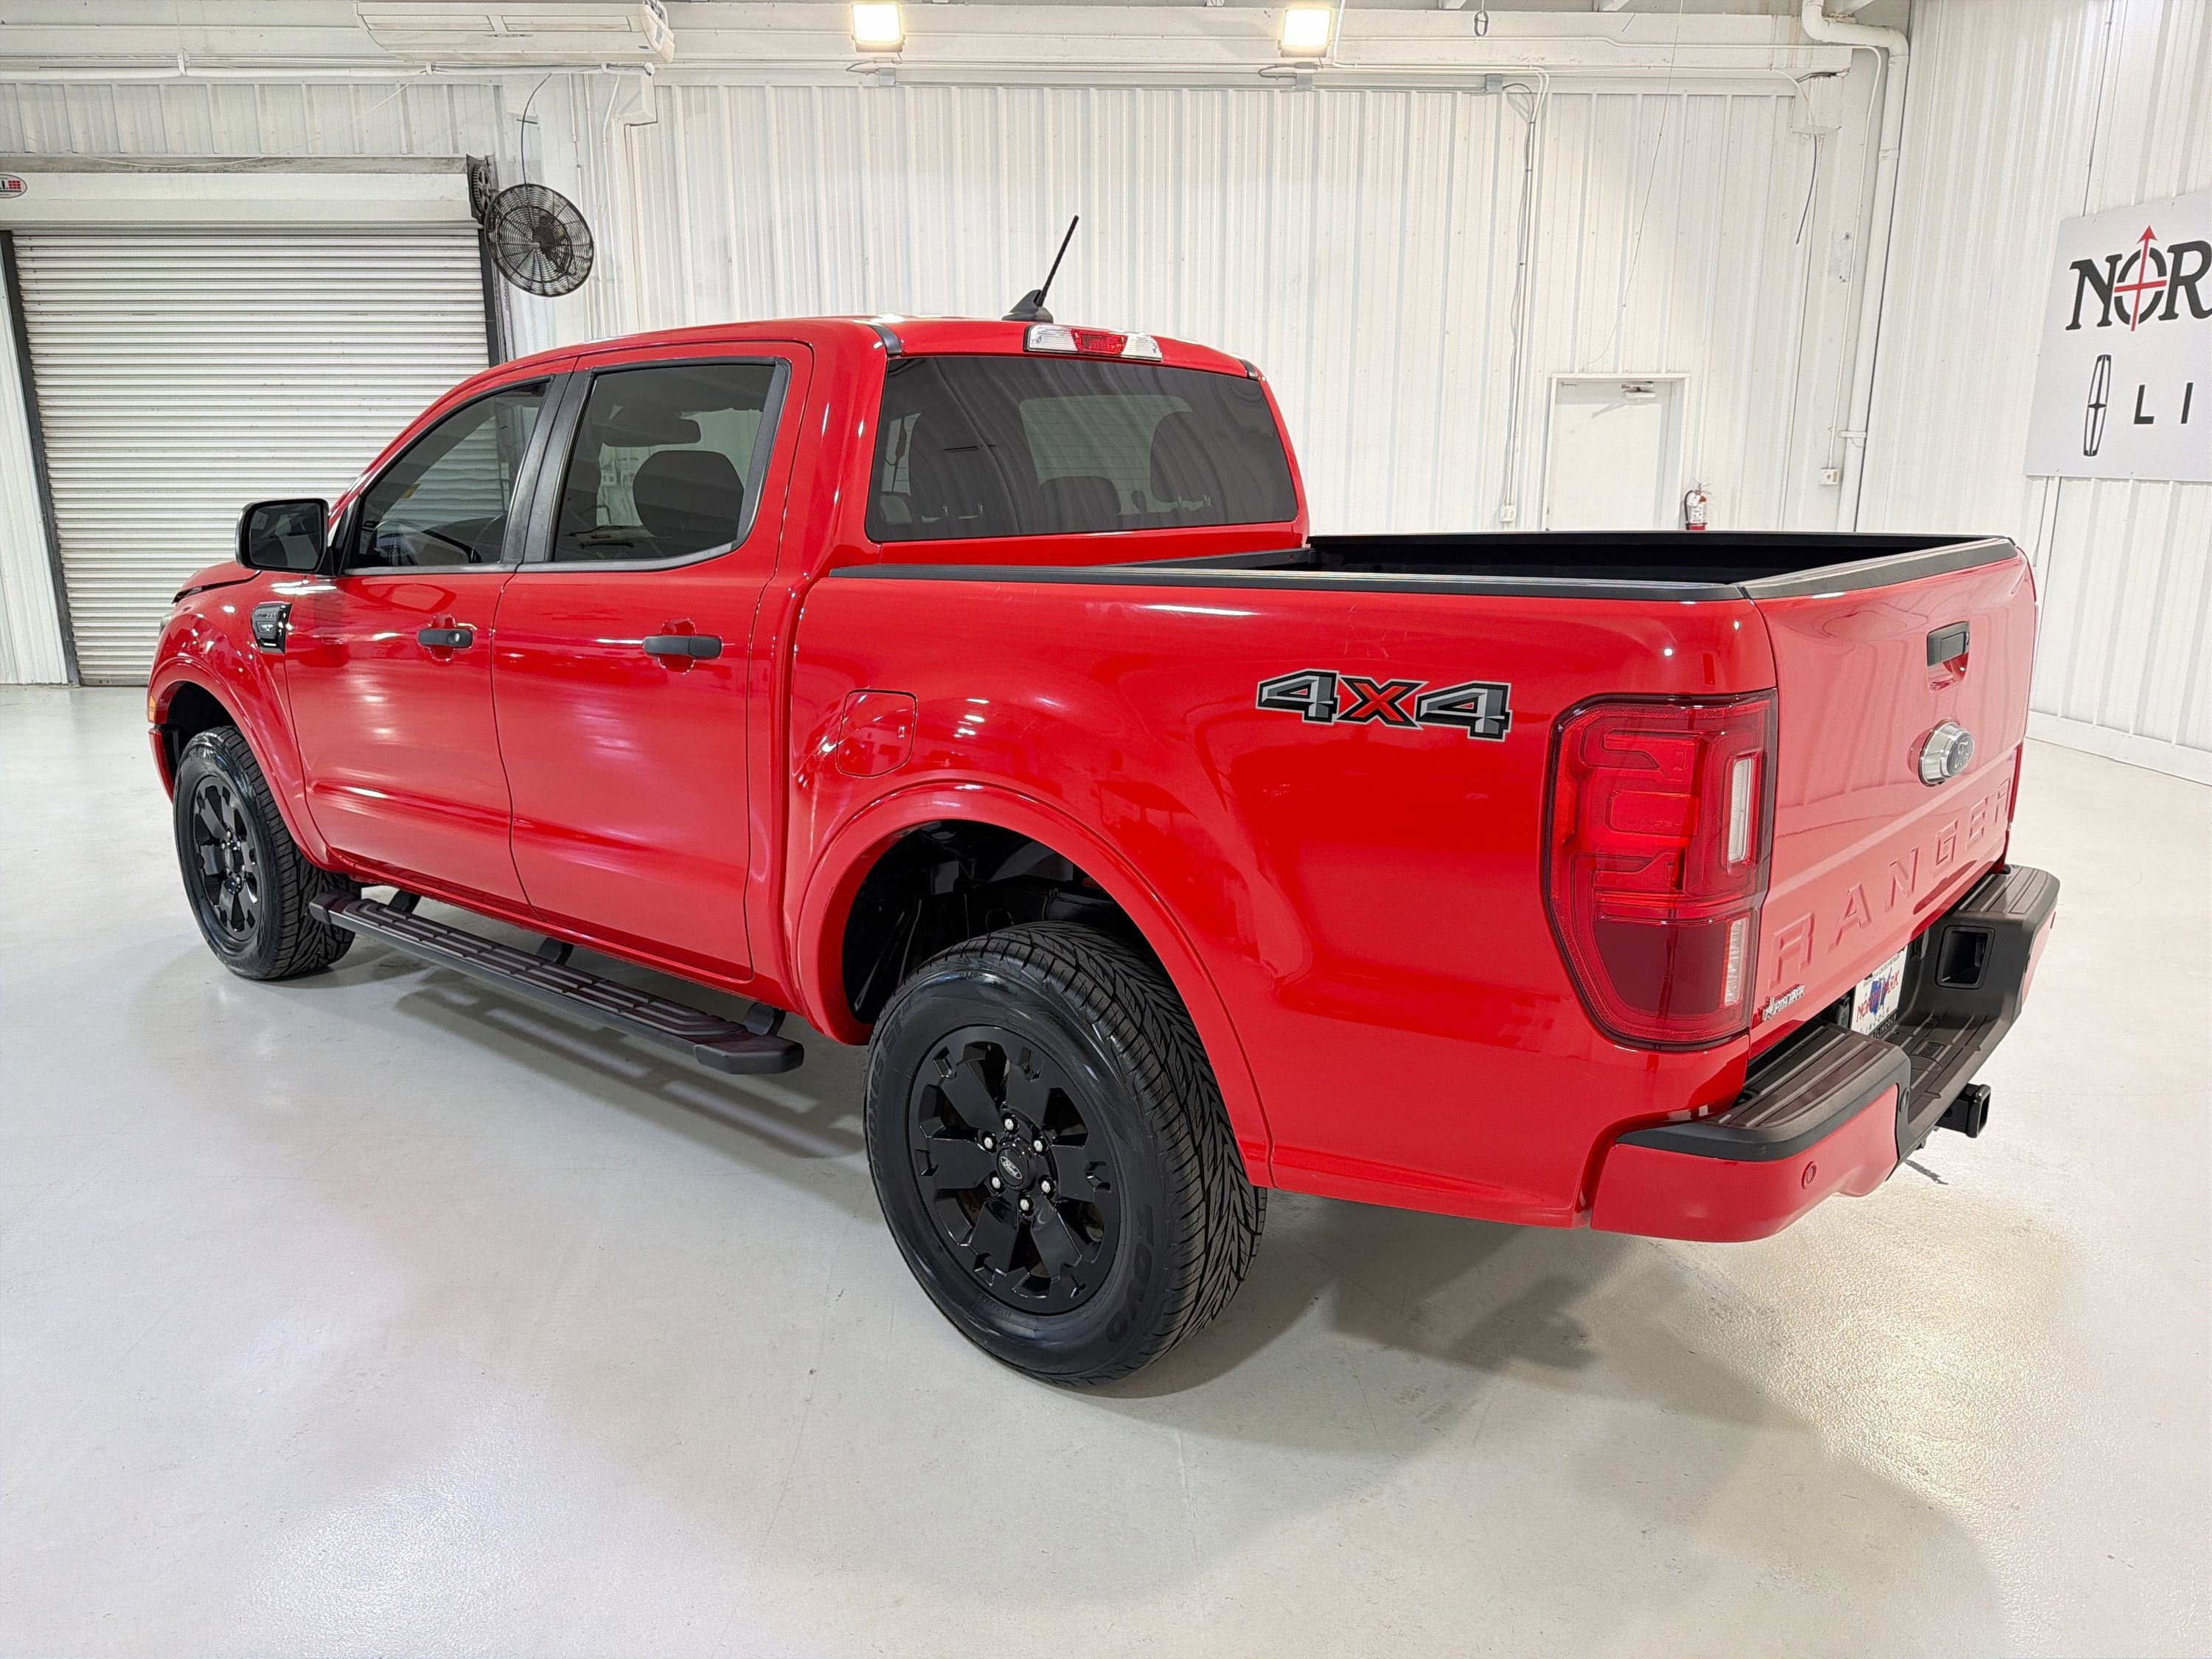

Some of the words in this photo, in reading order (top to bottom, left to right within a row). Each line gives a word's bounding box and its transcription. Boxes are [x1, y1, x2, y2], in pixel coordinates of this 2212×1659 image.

[2133, 382, 2194, 425] LI
[1768, 778, 2011, 990] RANGER
[1002, 1159, 1019, 1176] Ford
